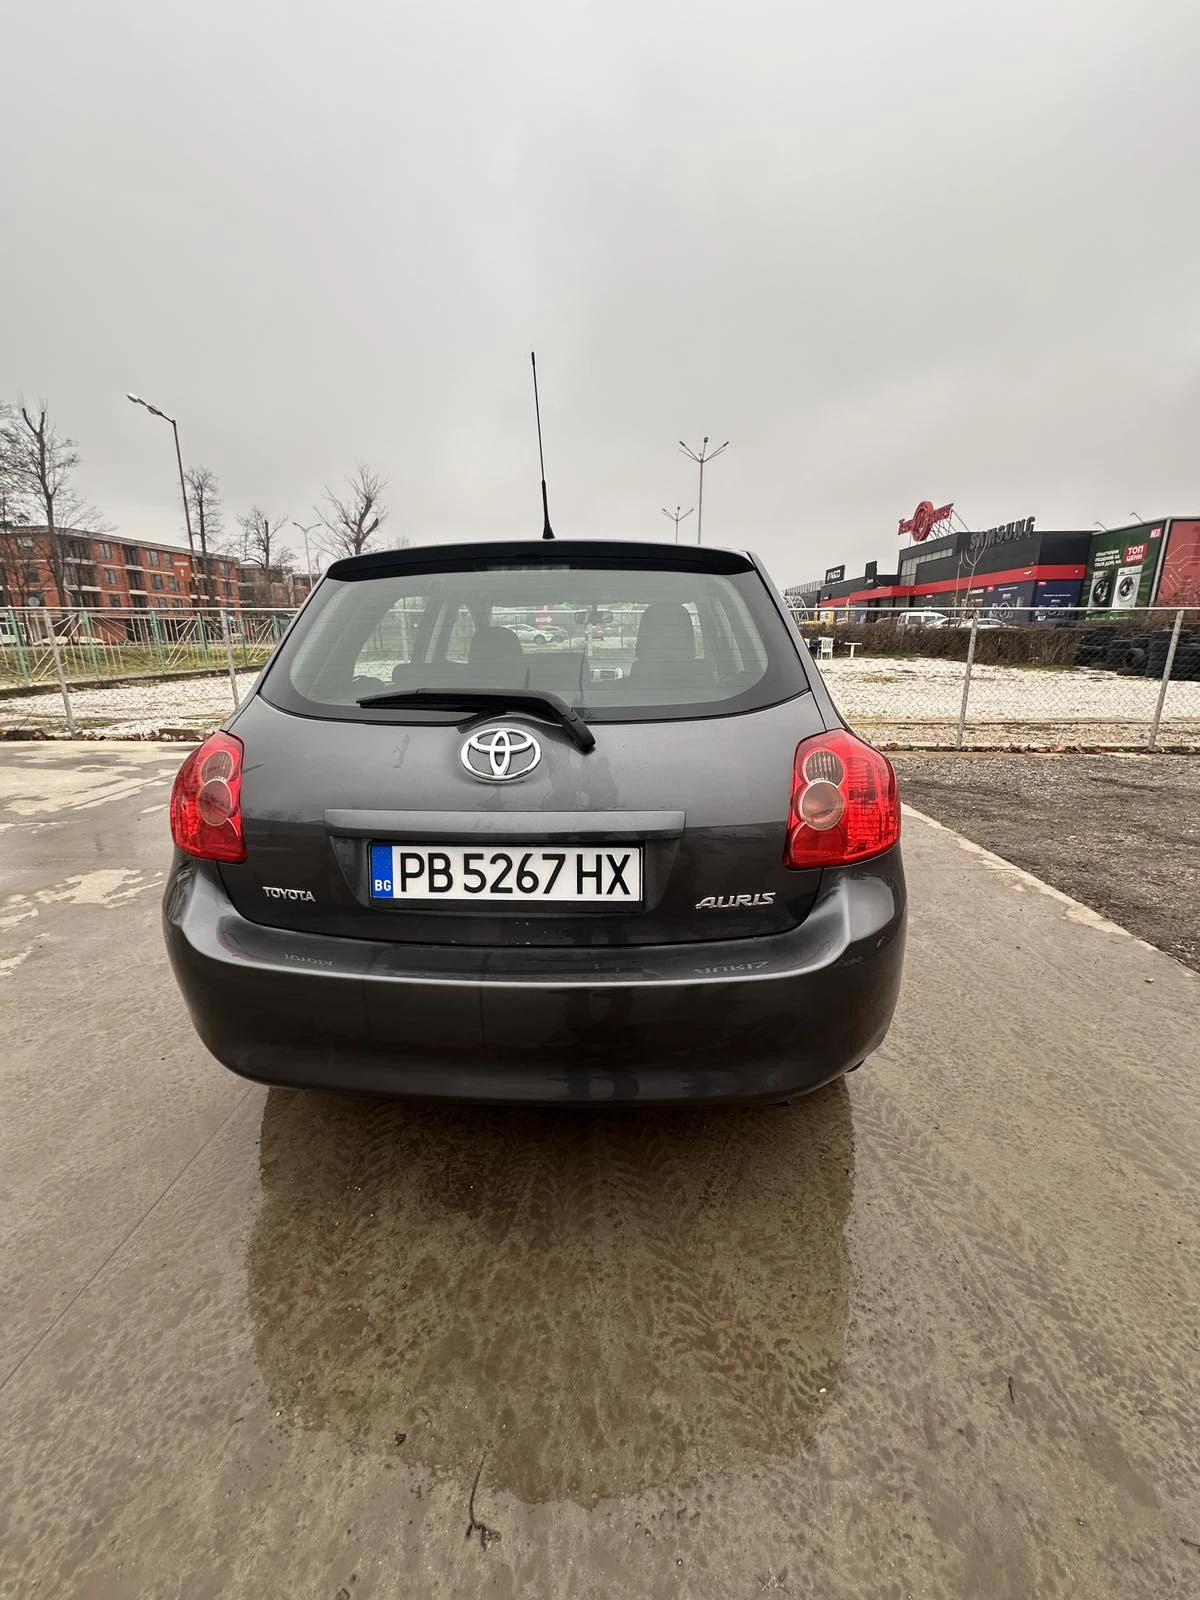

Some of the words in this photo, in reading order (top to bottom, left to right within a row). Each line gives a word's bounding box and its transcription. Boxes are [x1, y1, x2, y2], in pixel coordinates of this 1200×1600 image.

[970, 516, 1036, 549] SAMSUNG
[1126, 553, 1142, 562] ЦЕНИ
[1128, 545, 1144, 555] ТОП
[400, 852, 453, 893] PB
[463, 853, 566, 894] 5267
[576, 854, 631, 895] HX
[375, 879, 391, 892] BG
[262, 886, 316, 902] TOYOTA
[695, 892, 776, 909] AURIS
